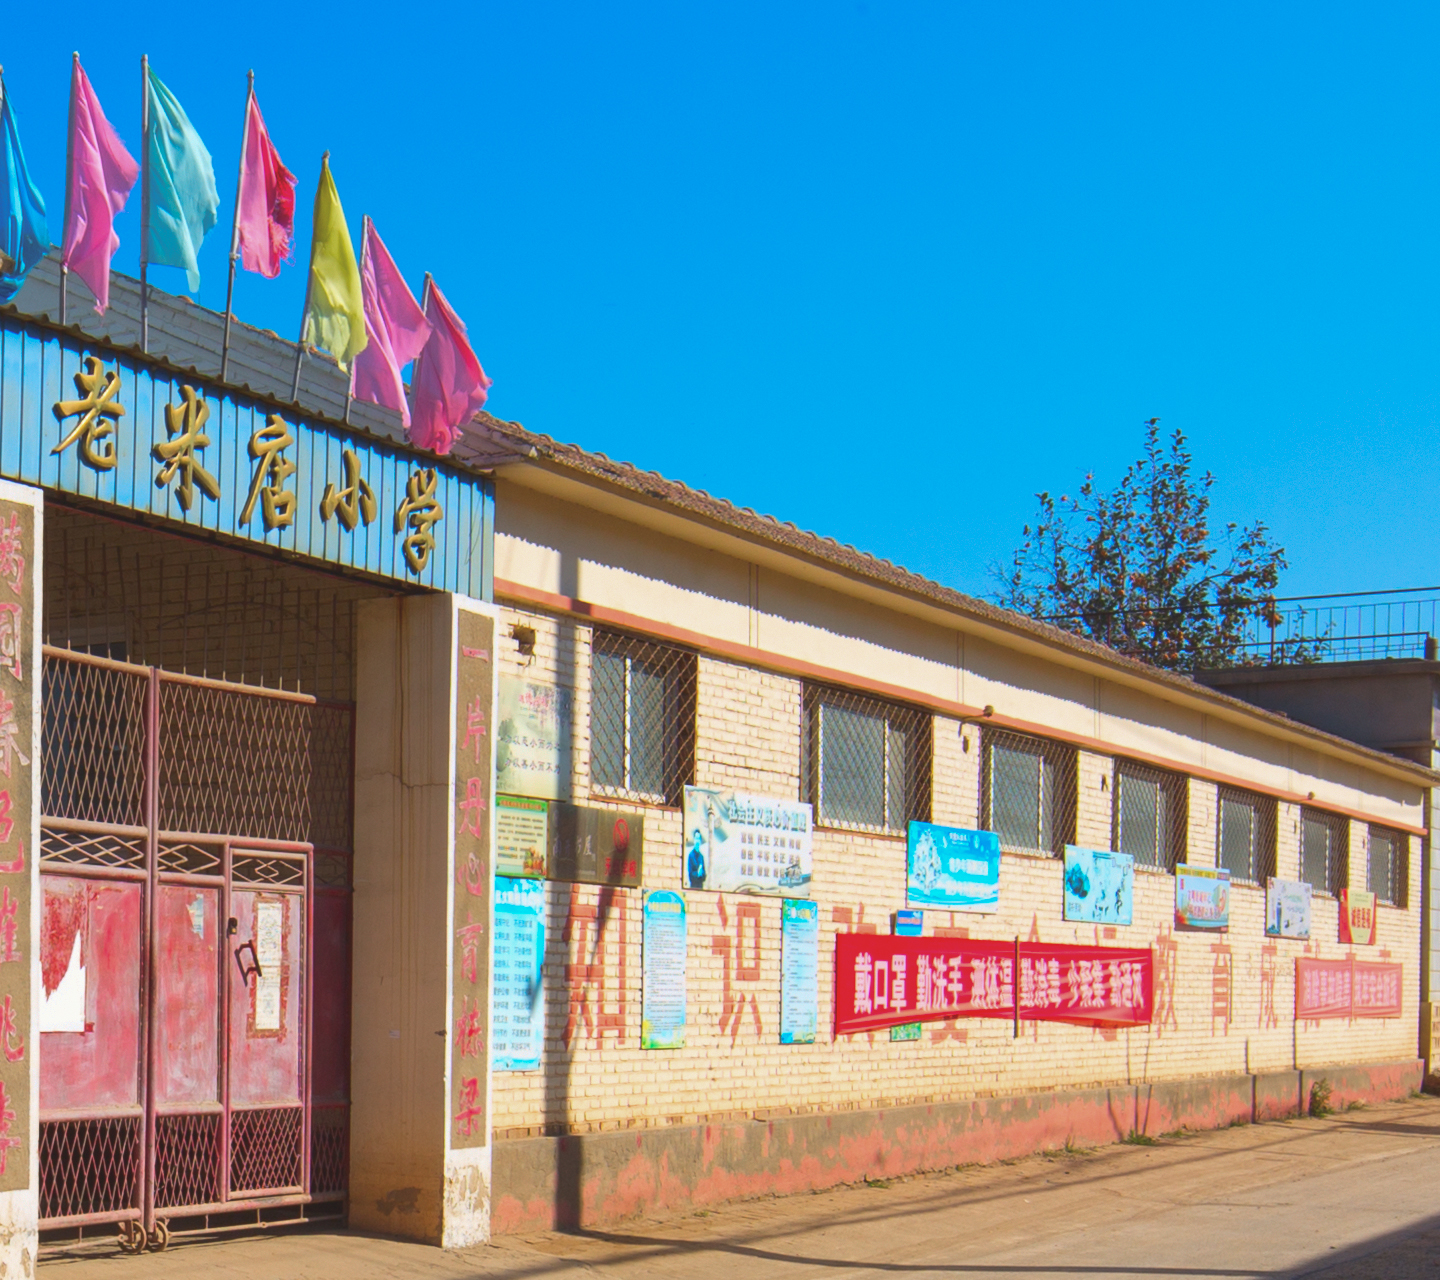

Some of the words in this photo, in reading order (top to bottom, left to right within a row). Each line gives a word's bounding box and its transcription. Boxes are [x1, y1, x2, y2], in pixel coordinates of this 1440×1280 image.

[854, 951, 907, 1014] 戴口罩
[917, 954, 963, 1011] 勤洗手
